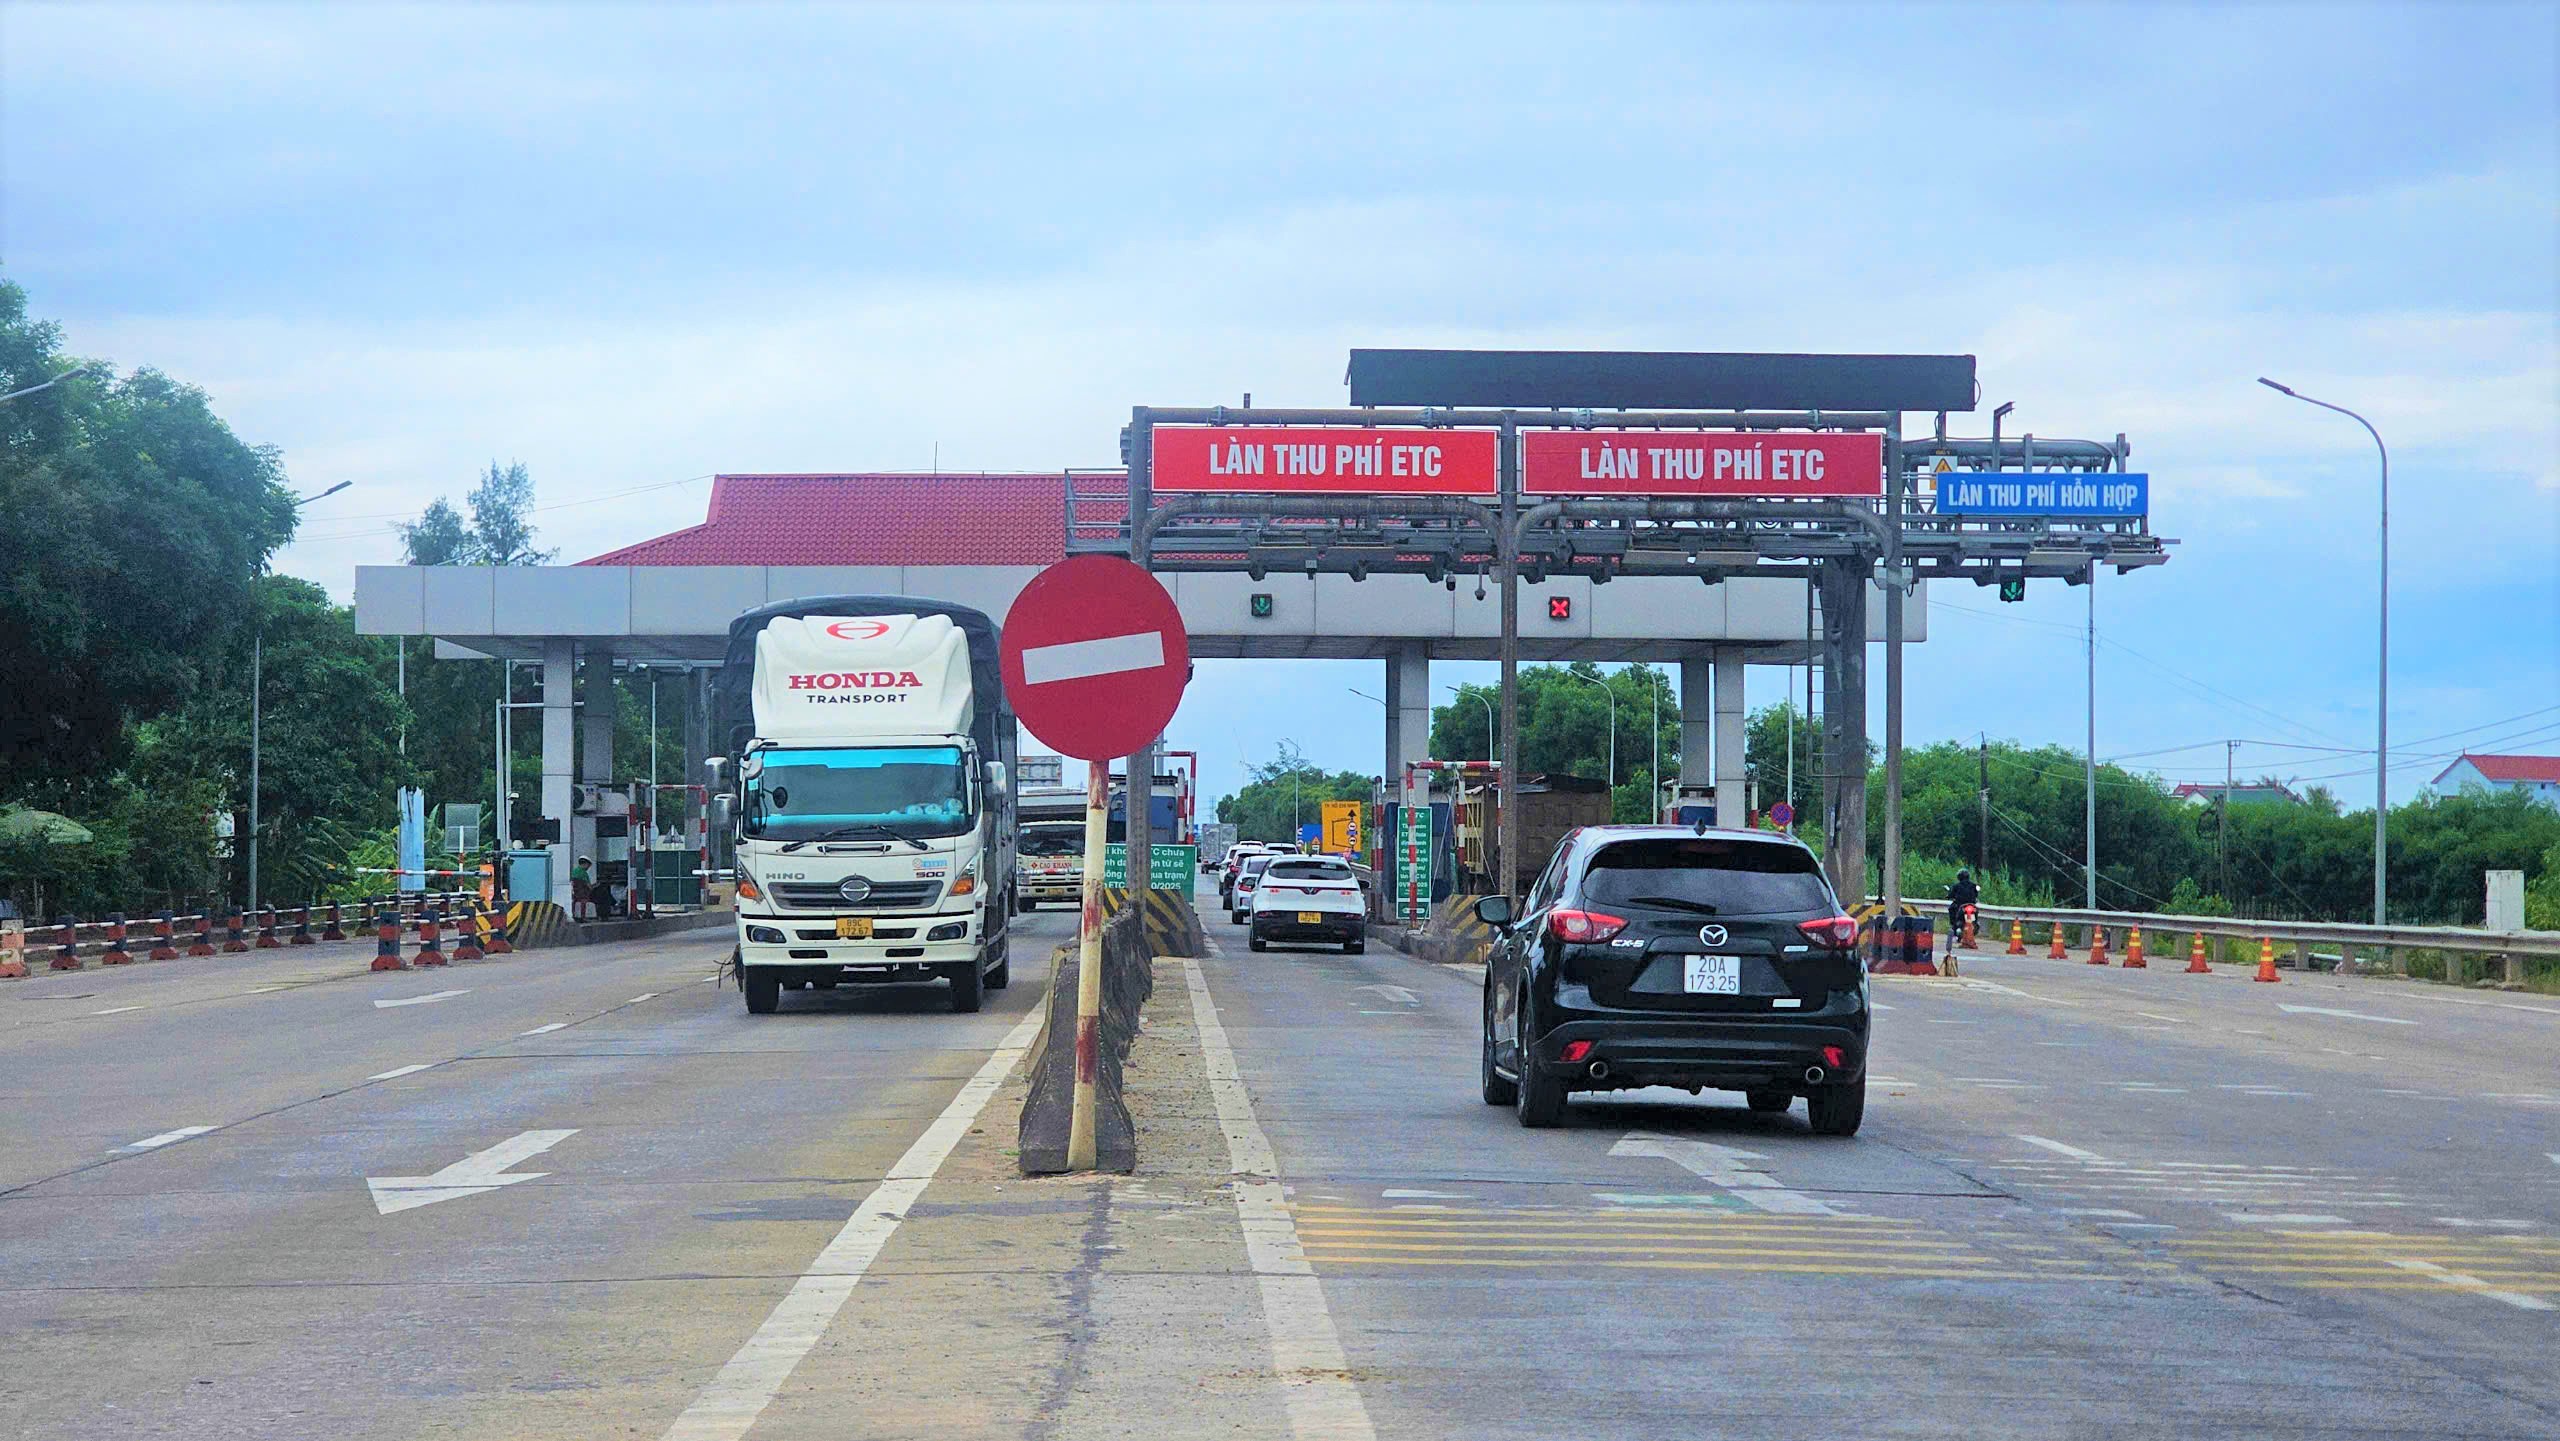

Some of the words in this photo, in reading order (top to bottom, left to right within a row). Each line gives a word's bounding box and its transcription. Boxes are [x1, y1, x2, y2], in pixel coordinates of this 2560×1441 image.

[1209, 436, 1265, 475] LÀN
[1272, 444, 1326, 475] THU
[1335, 437, 1384, 476] PHÍ
[1391, 445, 1442, 477] ETC
[1581, 440, 1639, 479] LÀN
[1648, 448, 1704, 480] THU
[1713, 442, 1764, 480] PHÍ
[1772, 449, 1825, 481] ETC
[1949, 480, 1983, 507] LÀN
[1988, 484, 2021, 507] THU
[2027, 480, 2056, 507] PHÍ
[2061, 477, 2098, 507] HỖN
[2103, 482, 2139, 511] HỢP
[788, 671, 923, 690] HONDA
[806, 693, 908, 704] TRANSPORT
[1111, 847, 1127, 855] kho
[1161, 848, 1184, 857] chưa
[765, 872, 806, 880] HINO
[915, 871, 946, 879] 500
[1611, 939, 1645, 948] CX-5
[1698, 957, 1726, 974] 20A
[1689, 975, 1737, 992] 173.25
